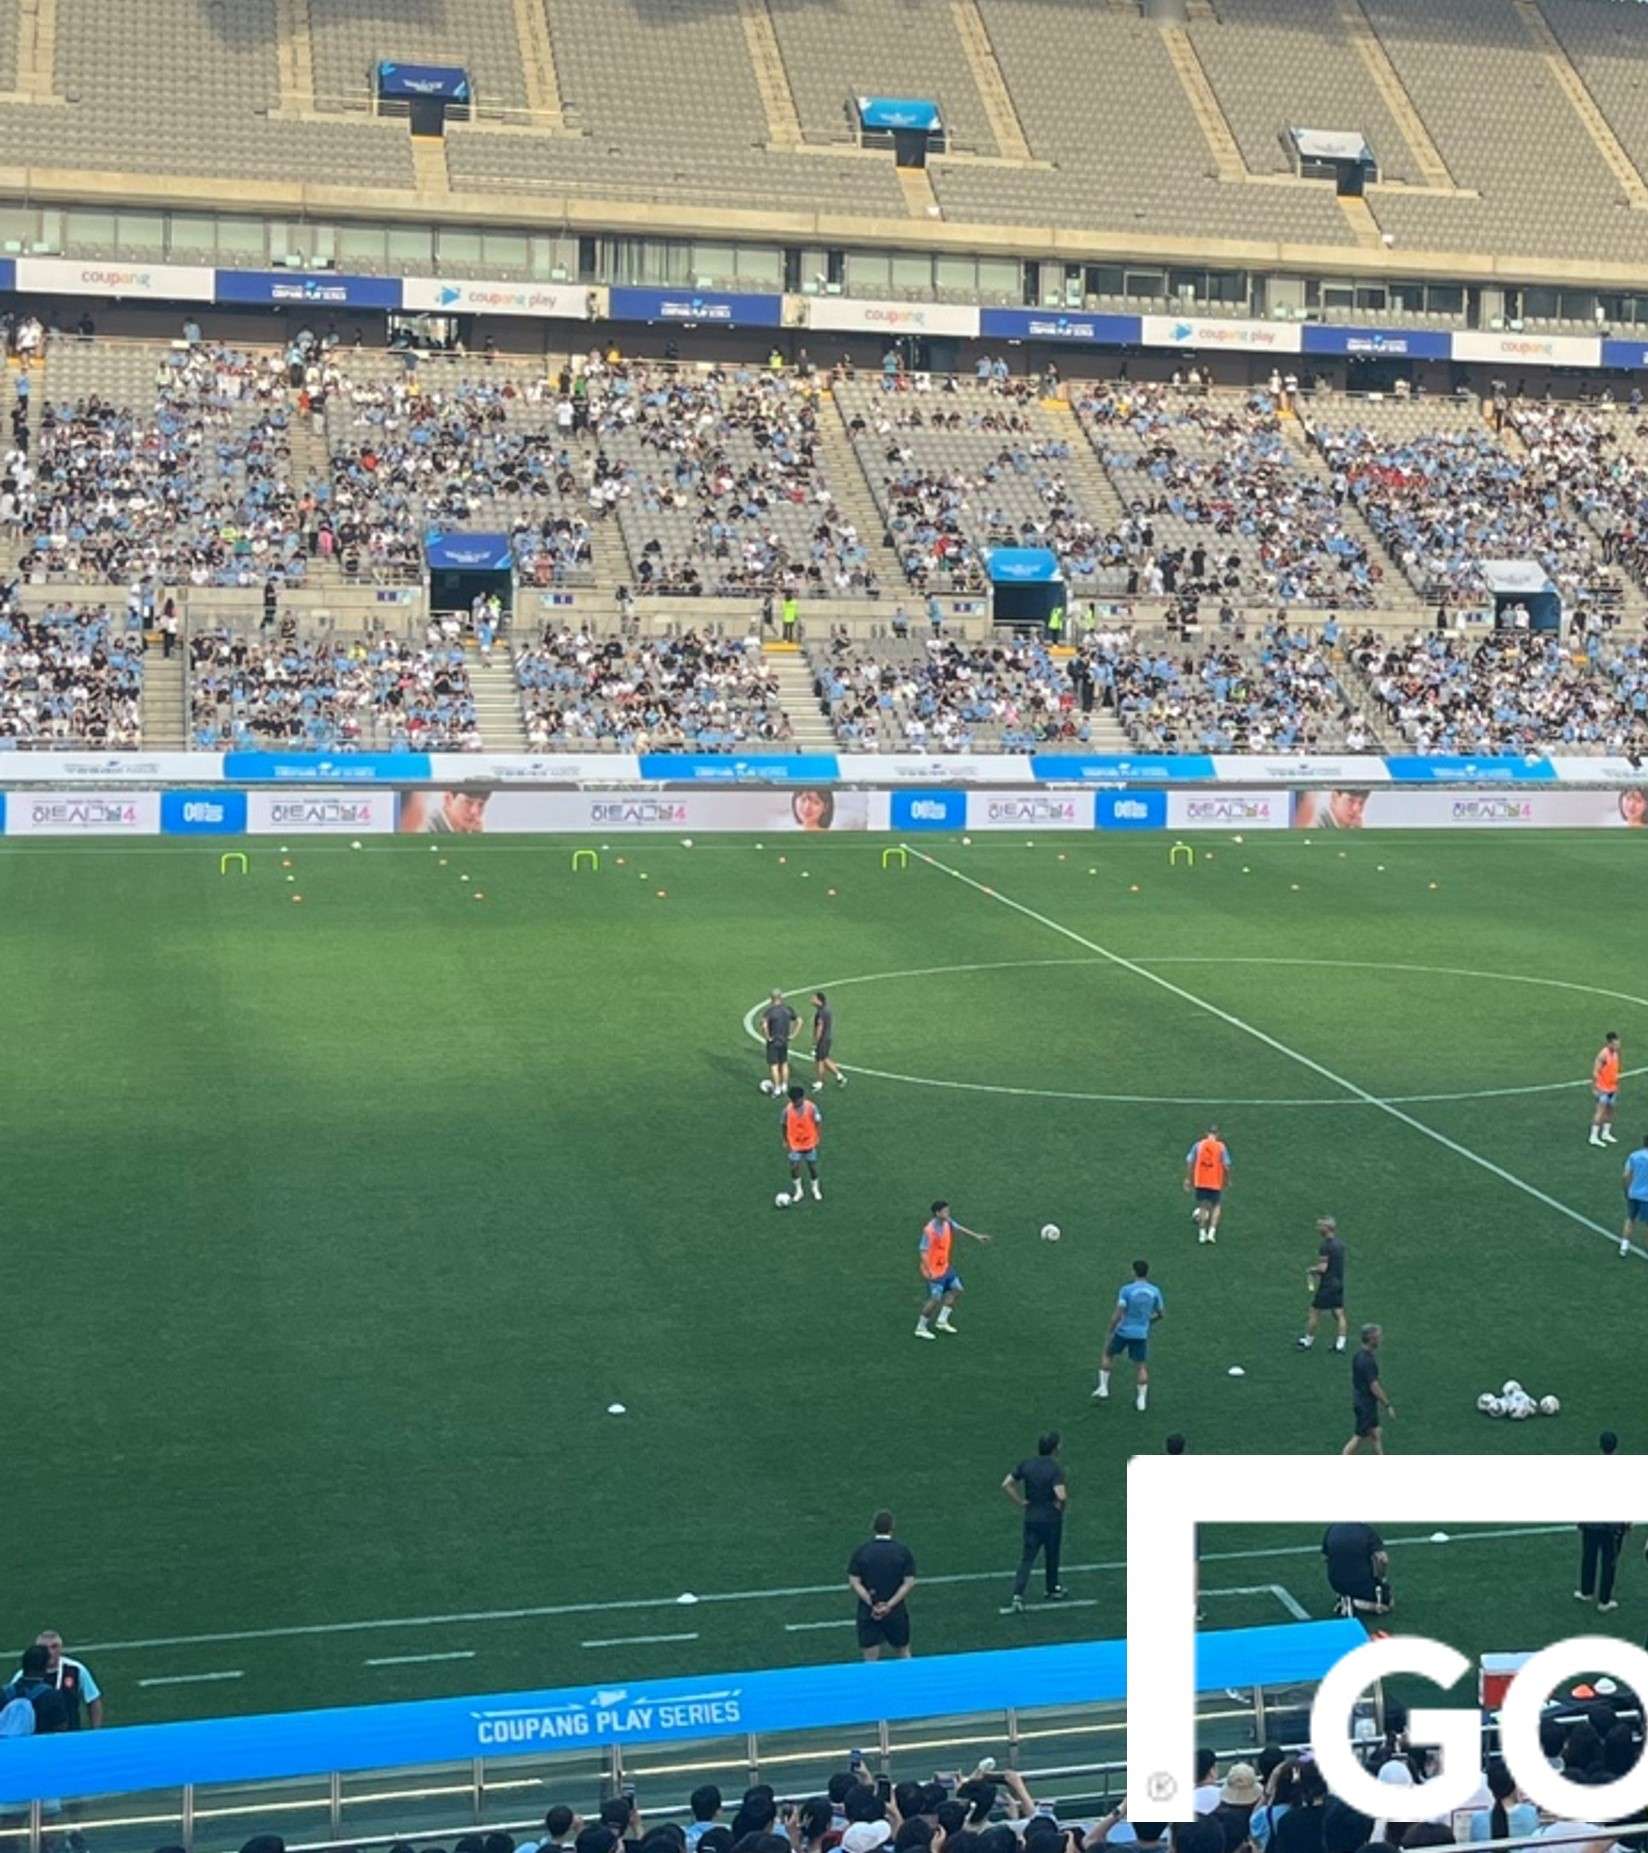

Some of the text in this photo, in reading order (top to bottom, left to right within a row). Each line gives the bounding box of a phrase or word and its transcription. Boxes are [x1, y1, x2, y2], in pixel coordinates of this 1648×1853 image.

[81, 271, 151, 288] coupang
[468, 291, 557, 310] coupang play
[478, 1701, 740, 1744] COUPANG PLAY SERIES
